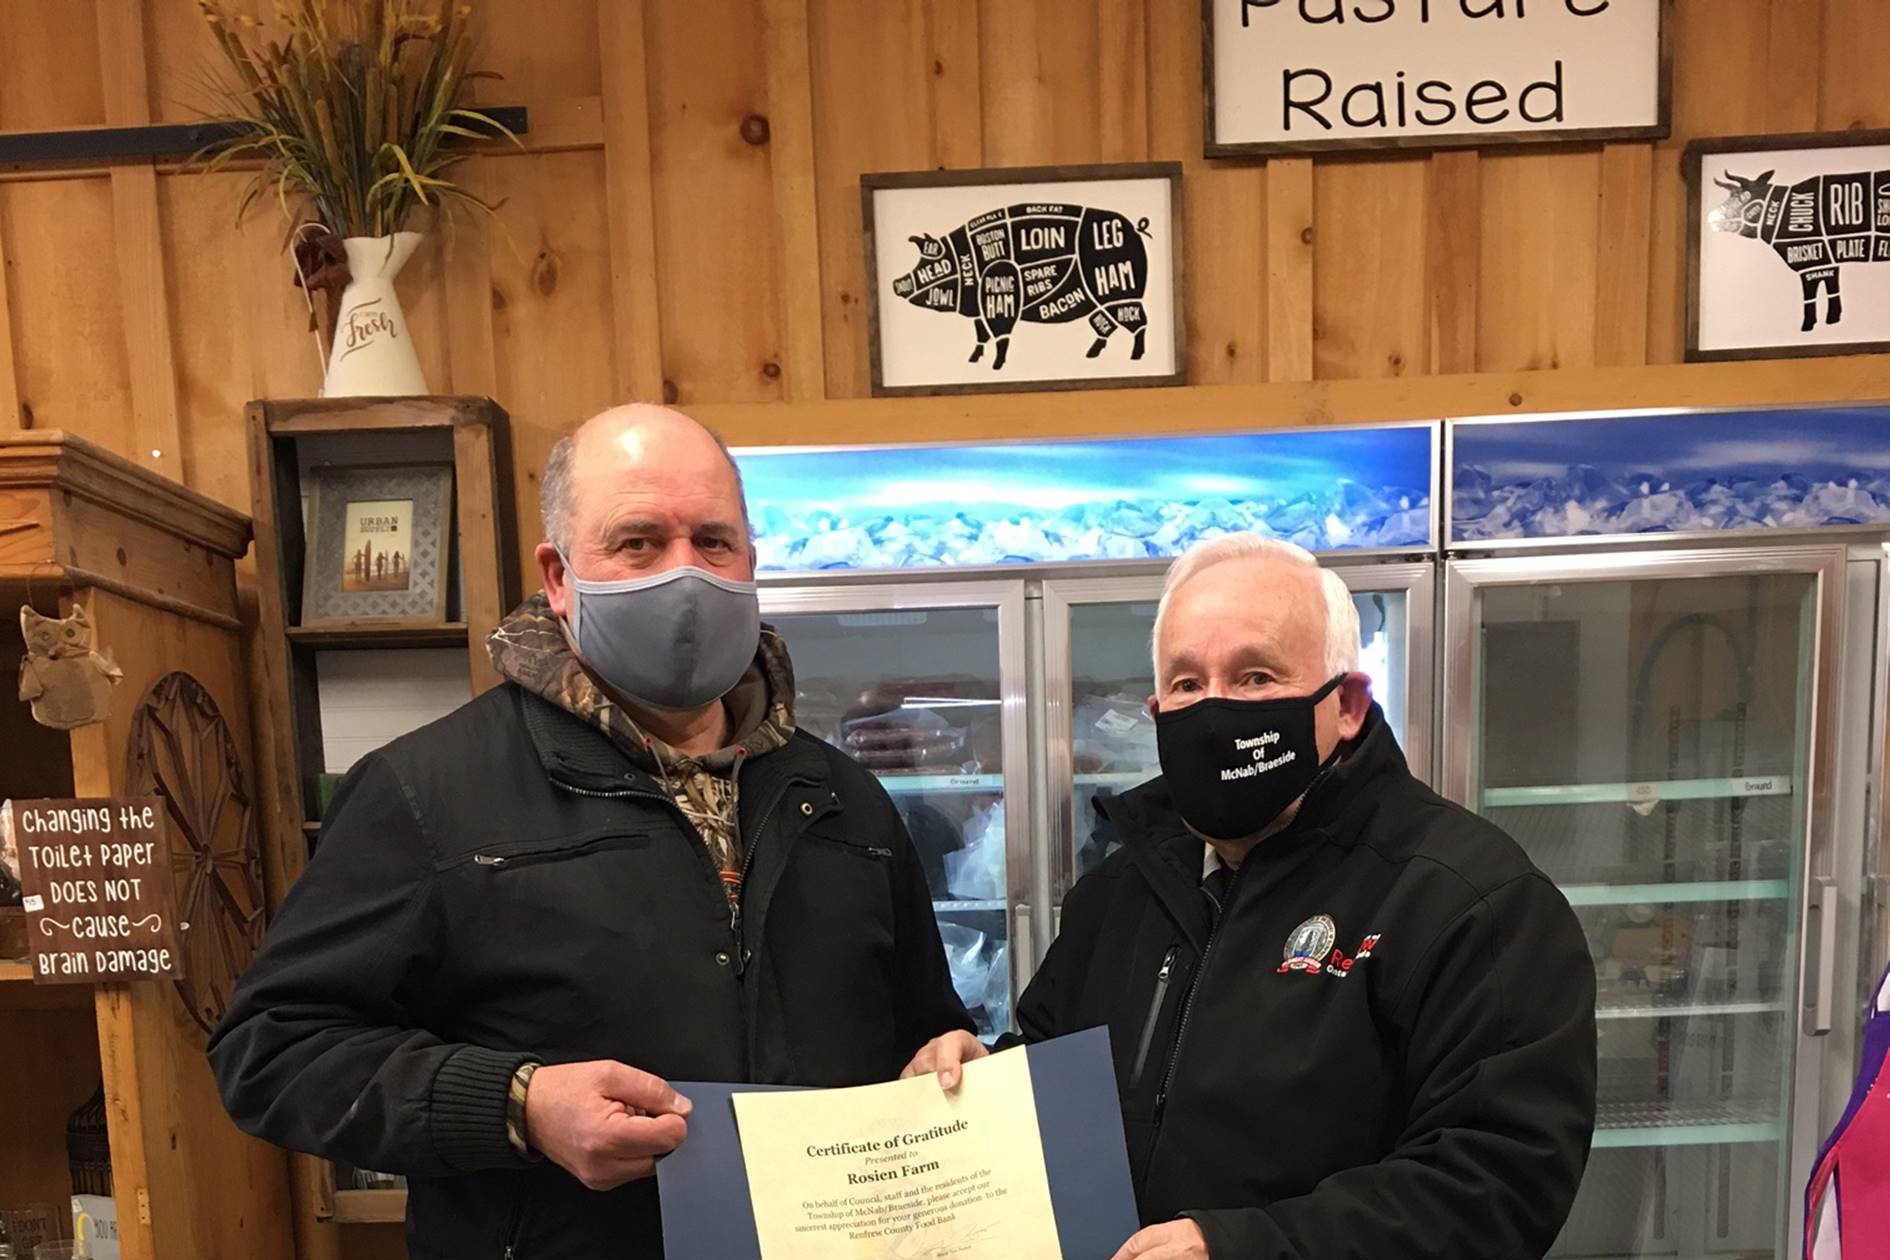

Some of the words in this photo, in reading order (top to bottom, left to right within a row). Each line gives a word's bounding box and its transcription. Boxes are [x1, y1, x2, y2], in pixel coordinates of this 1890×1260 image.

[1283, 60, 1564, 131] Raised
[1026, 206, 1047, 214] BACK
[1765, 200, 1781, 226] NECK
[1788, 192, 1815, 232] CHUCK
[1830, 182, 1863, 226] RIB
[976, 228, 1006, 246] BOSTON
[1020, 226, 1065, 251] LOIN
[1092, 218, 1124, 250] LEG
[923, 241, 939, 255] EAR
[981, 241, 1006, 261] BUTT
[1787, 242, 1823, 264] BRISKET
[1836, 238, 1865, 260] PLATE
[917, 259, 952, 284] HEAD
[960, 254, 974, 286] NECK
[1023, 265, 1058, 281] SPARE
[1094, 260, 1136, 296] HAM
[1805, 269, 1835, 281] SHANK
[925, 287, 954, 307] JOWL
[985, 275, 1015, 293] PICNIC
[1026, 279, 1053, 297] RIBS
[986, 293, 1015, 319] HAM
[1039, 287, 1087, 320] BACON
[1234, 730, 1280, 750] Township
[1221, 750, 1296, 780] McNab/Braeside
[1253, 747, 1264, 760] Of
[22, 808, 111, 834] Changing
[119, 805, 155, 829] the
[50, 880, 98, 904] DOES
[104, 878, 142, 902] NOT
[38, 952, 89, 975] Brain
[95, 948, 172, 973] Damage
[806, 1141, 881, 1158] Certificate
[884, 1135, 900, 1149] of
[902, 1119, 969, 1146] Gratitude
[865, 1151, 907, 1166] Presented
[909, 1150, 918, 1158] to
[847, 1169, 898, 1185] Rosien
[901, 1160, 940, 1177] Farm
[802, 1201, 814, 1209] On
[815, 1199, 838, 1208] behalf
[884, 1190, 902, 1201] staff
[904, 1187, 919, 1198] and
[921, 1184, 933, 1193] the
[935, 1176, 969, 1190] residents
[970, 1171, 978, 1180] of
[979, 1169, 991, 1177] the
[808, 1210, 844, 1220] Township
[845, 1209, 853, 1217] of
[927, 1192, 950, 1205] please
[952, 1185, 975, 1197] accept
[977, 1181, 990, 1190] our
[829, 1219, 876, 1232] appreciation
[878, 1215, 890, 1224] for
[892, 1214, 911, 1226] your
[912, 1206, 948, 1221] generous
[949, 1194, 983, 1209] donation
[985, 1191, 994, 1199] to
[995, 1187, 1007, 1196] the
[849, 1229, 882, 1239] Renfrew
[884, 1224, 914, 1235] County
[915, 1218, 935, 1229] Food
[937, 1213, 956, 1225] Bank
